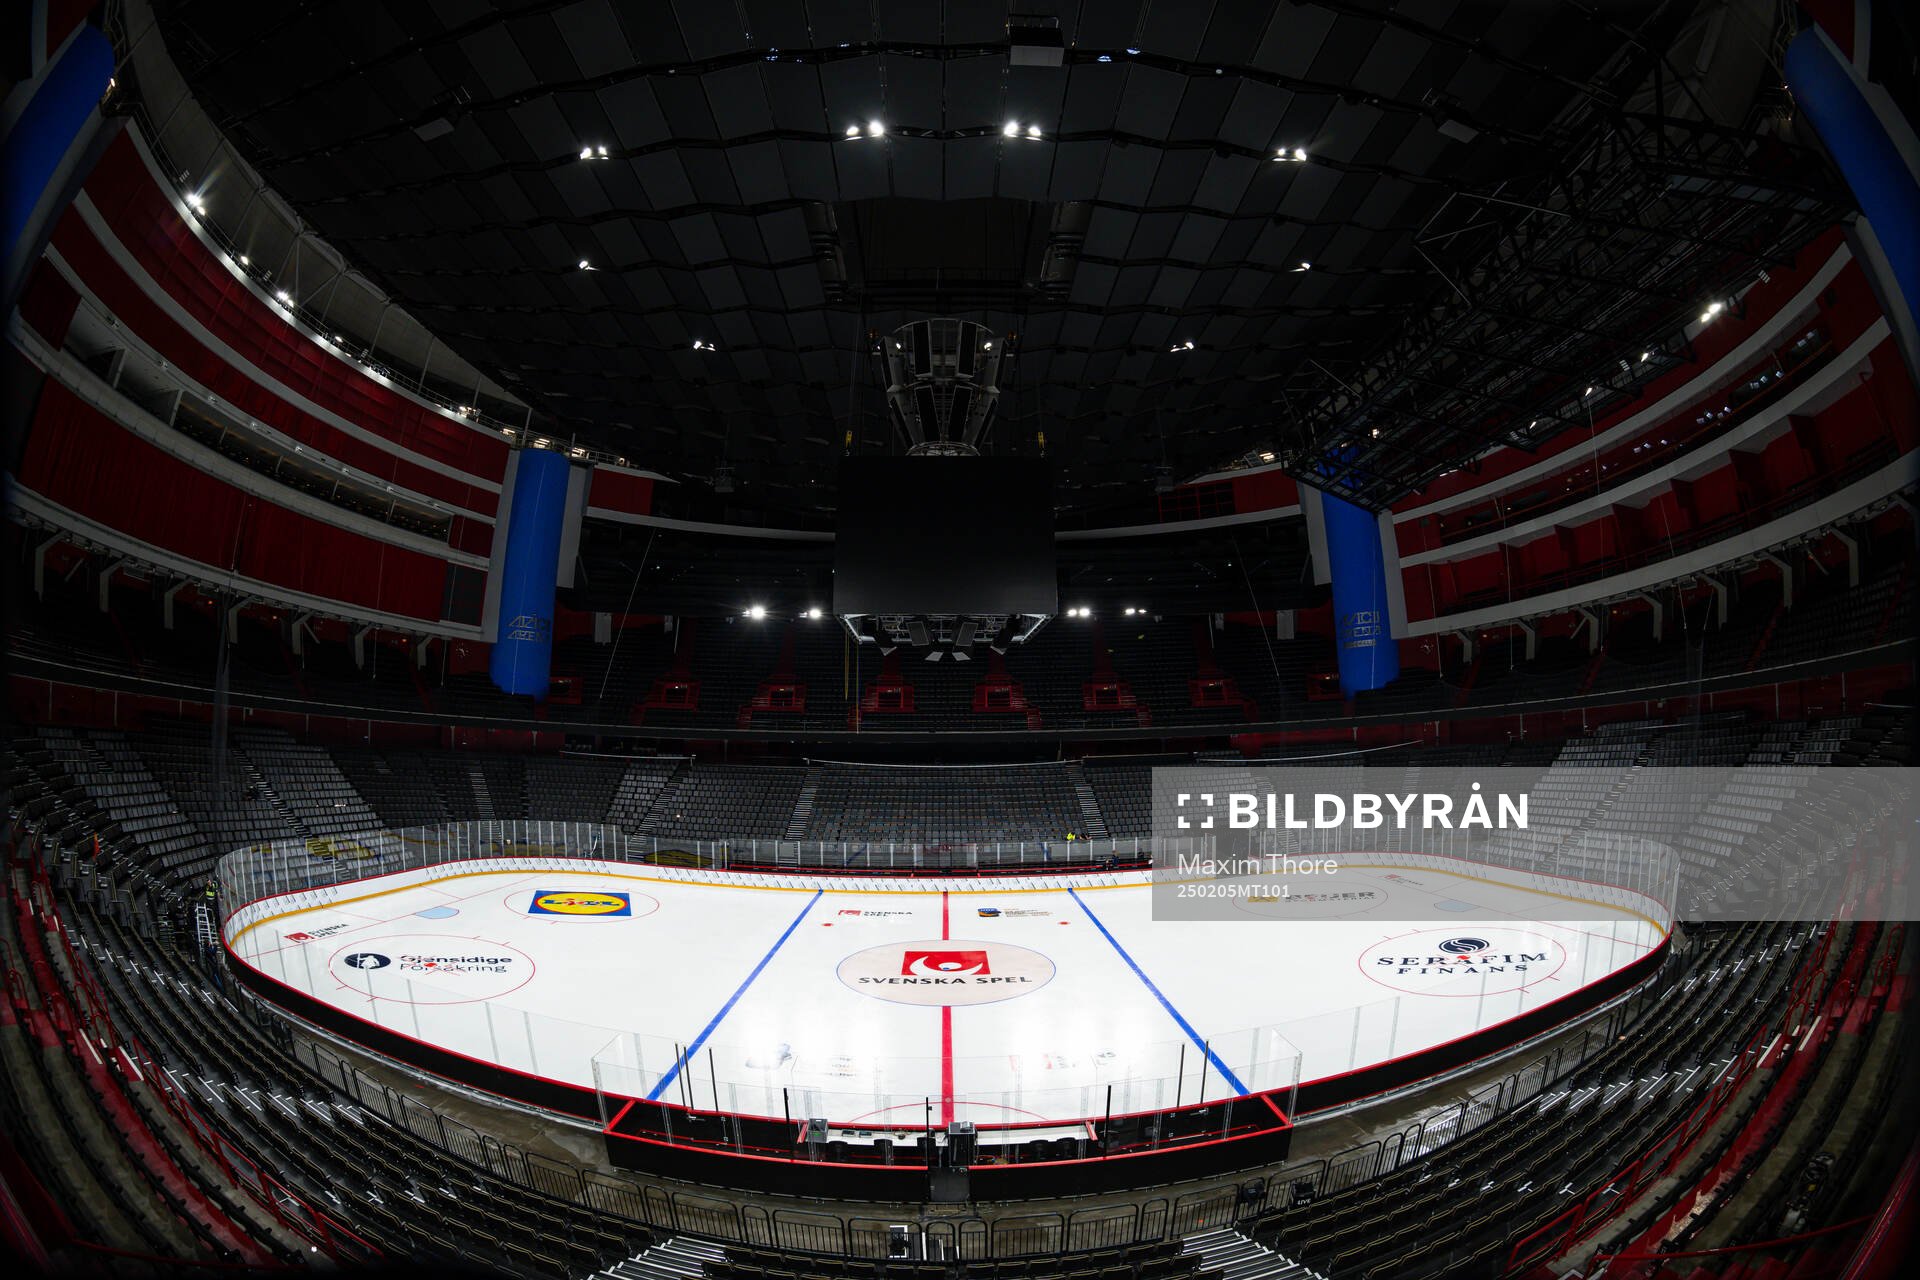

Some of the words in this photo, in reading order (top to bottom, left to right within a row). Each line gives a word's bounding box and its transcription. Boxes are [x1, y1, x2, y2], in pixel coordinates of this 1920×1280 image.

[400, 955, 512, 964] Gjensidige
[1377, 953, 1548, 966] SERAFIM
[1397, 965, 1528, 974] FINANS
[976, 976, 1033, 984] SPEL
